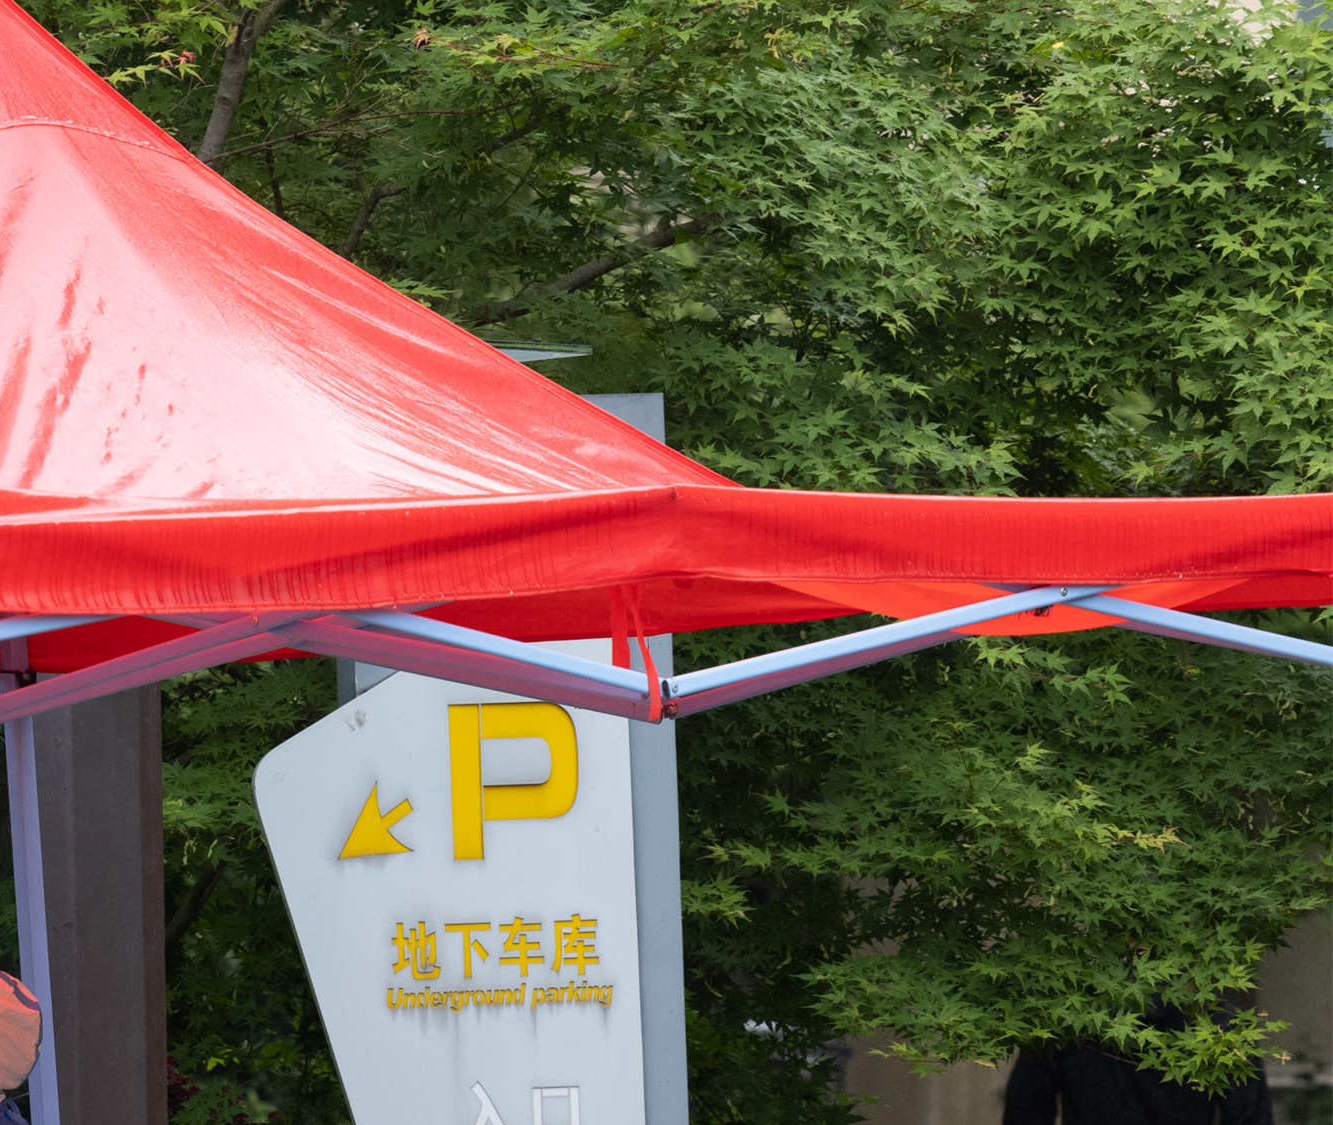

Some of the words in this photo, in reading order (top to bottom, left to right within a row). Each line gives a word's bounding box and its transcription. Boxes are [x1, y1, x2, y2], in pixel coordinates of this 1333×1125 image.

[447, 702, 579, 861] P
[391, 913, 600, 981] 地下车库
[386, 983, 527, 1012] Underground
[530, 981, 614, 1011] parking
